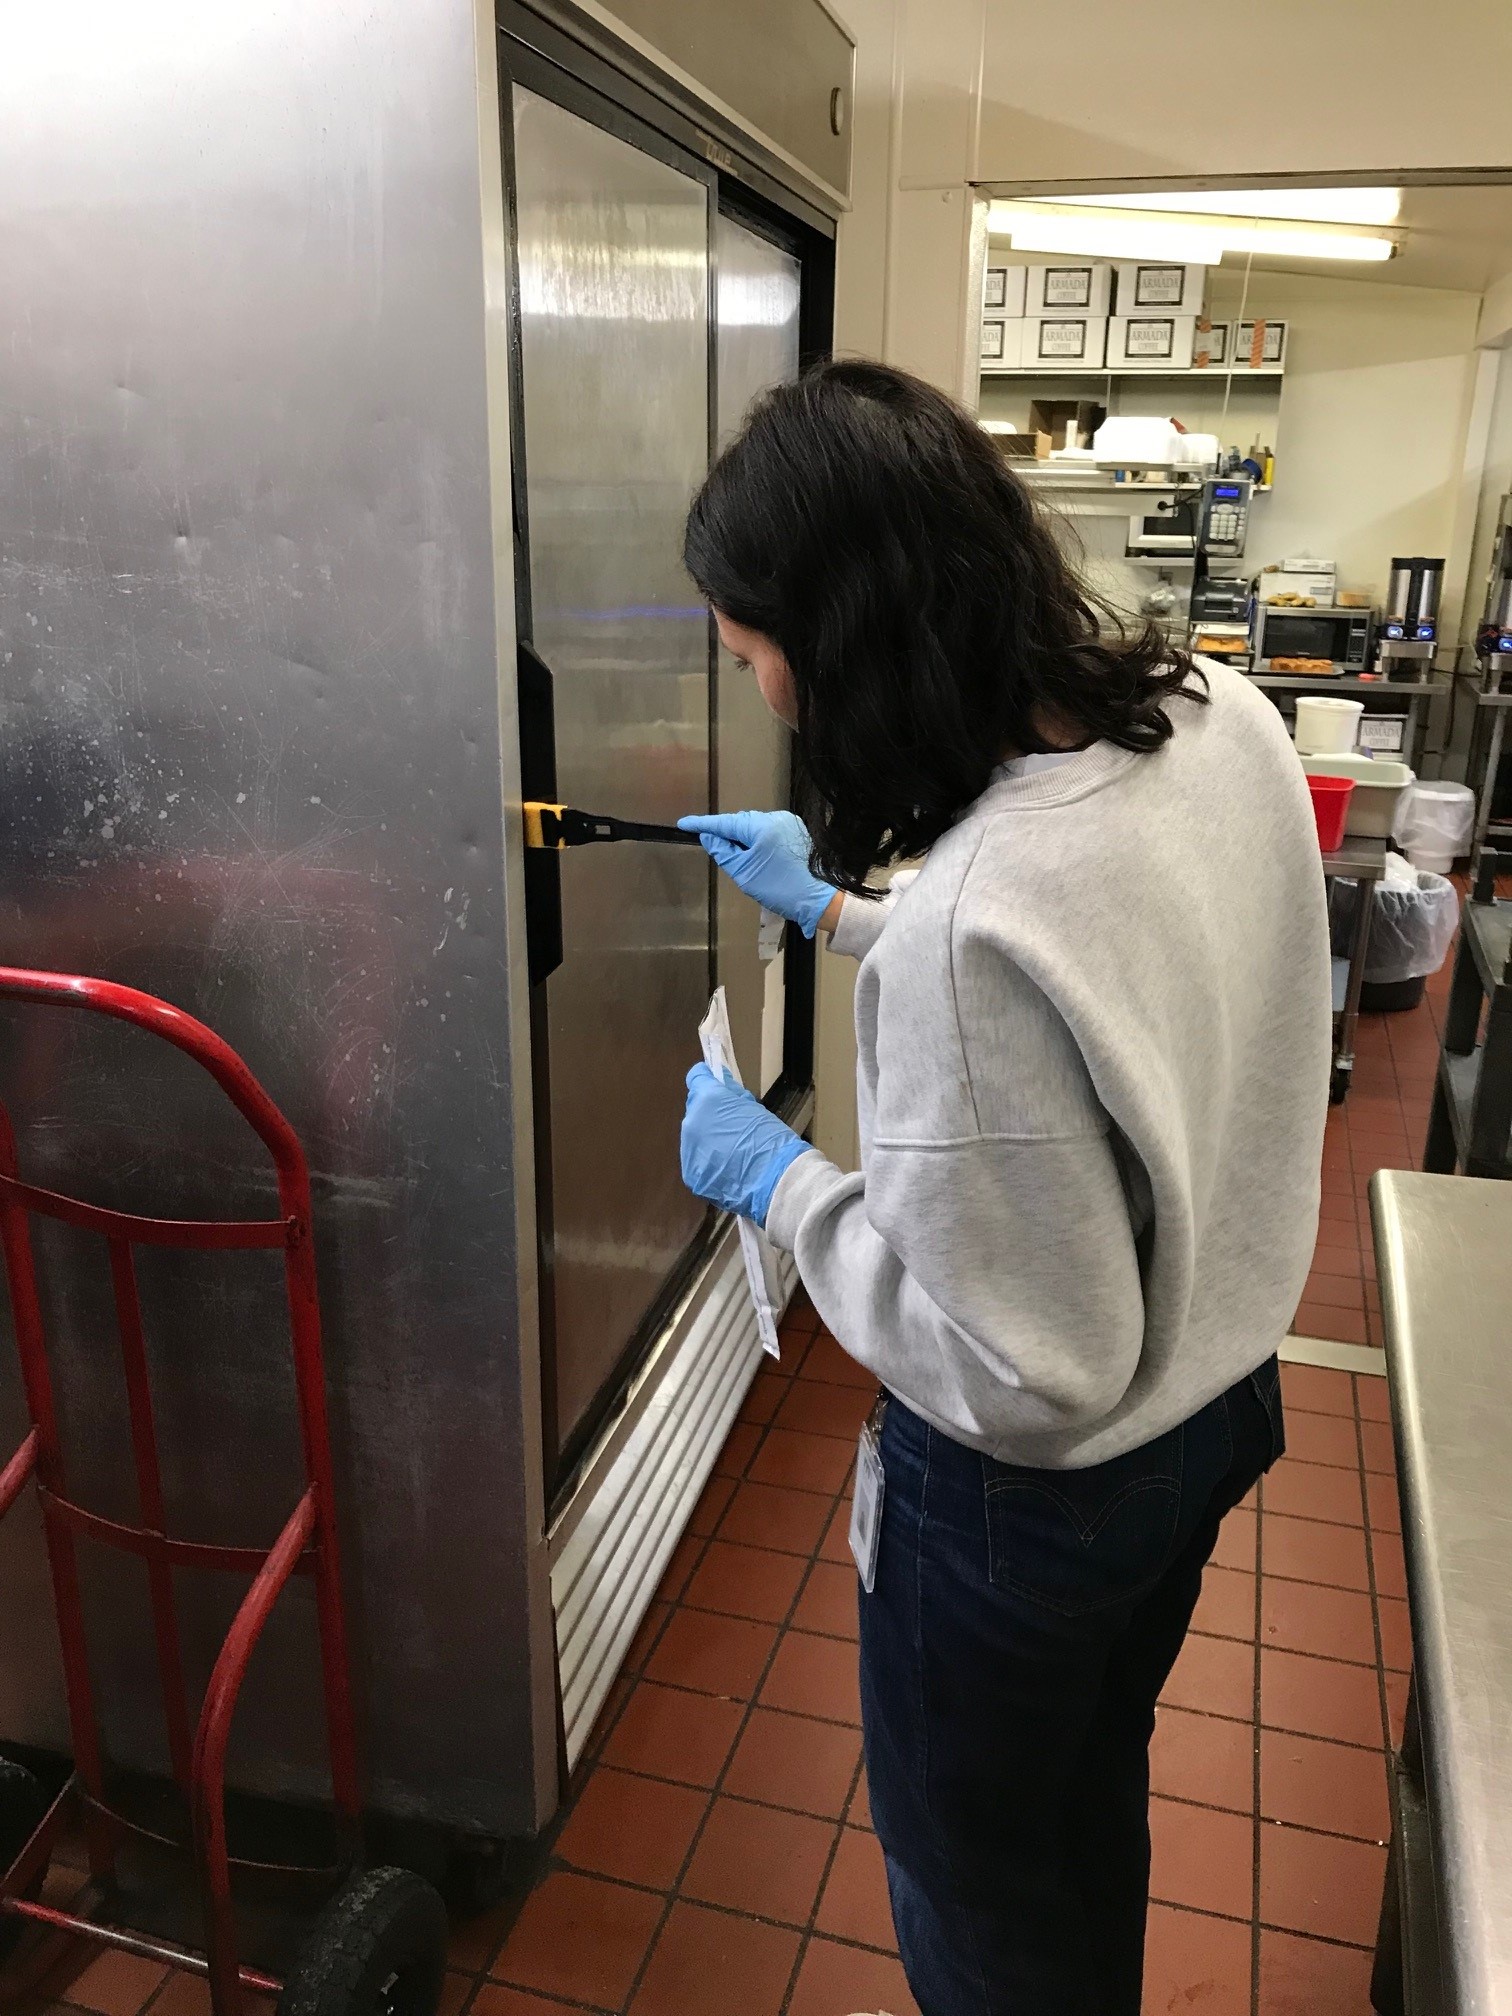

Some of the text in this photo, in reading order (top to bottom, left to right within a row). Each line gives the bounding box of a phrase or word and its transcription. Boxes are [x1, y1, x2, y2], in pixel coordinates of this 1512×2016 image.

[1049, 280, 1087, 290] ARMADA
[1142, 277, 1180, 288] ARMADA
[1045, 331, 1081, 341] ARMADA
[1131, 331, 1169, 341] ARMADA
[1362, 727, 1400, 737] ARMADA
